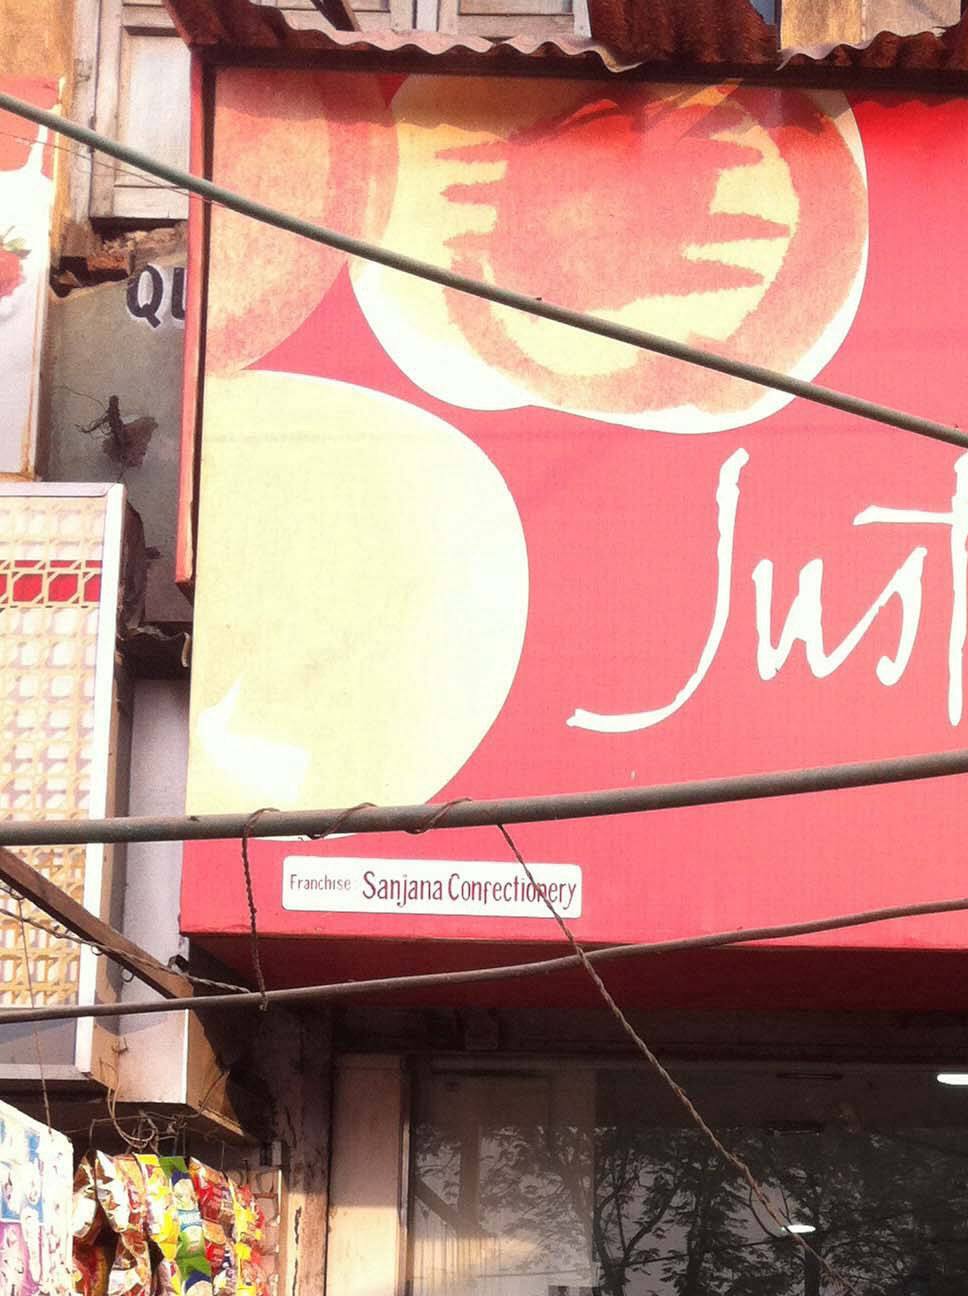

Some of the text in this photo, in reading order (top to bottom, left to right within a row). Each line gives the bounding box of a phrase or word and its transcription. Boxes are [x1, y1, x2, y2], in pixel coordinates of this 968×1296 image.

[289, 870, 577, 911] Franchise Sanjana Confectionery
